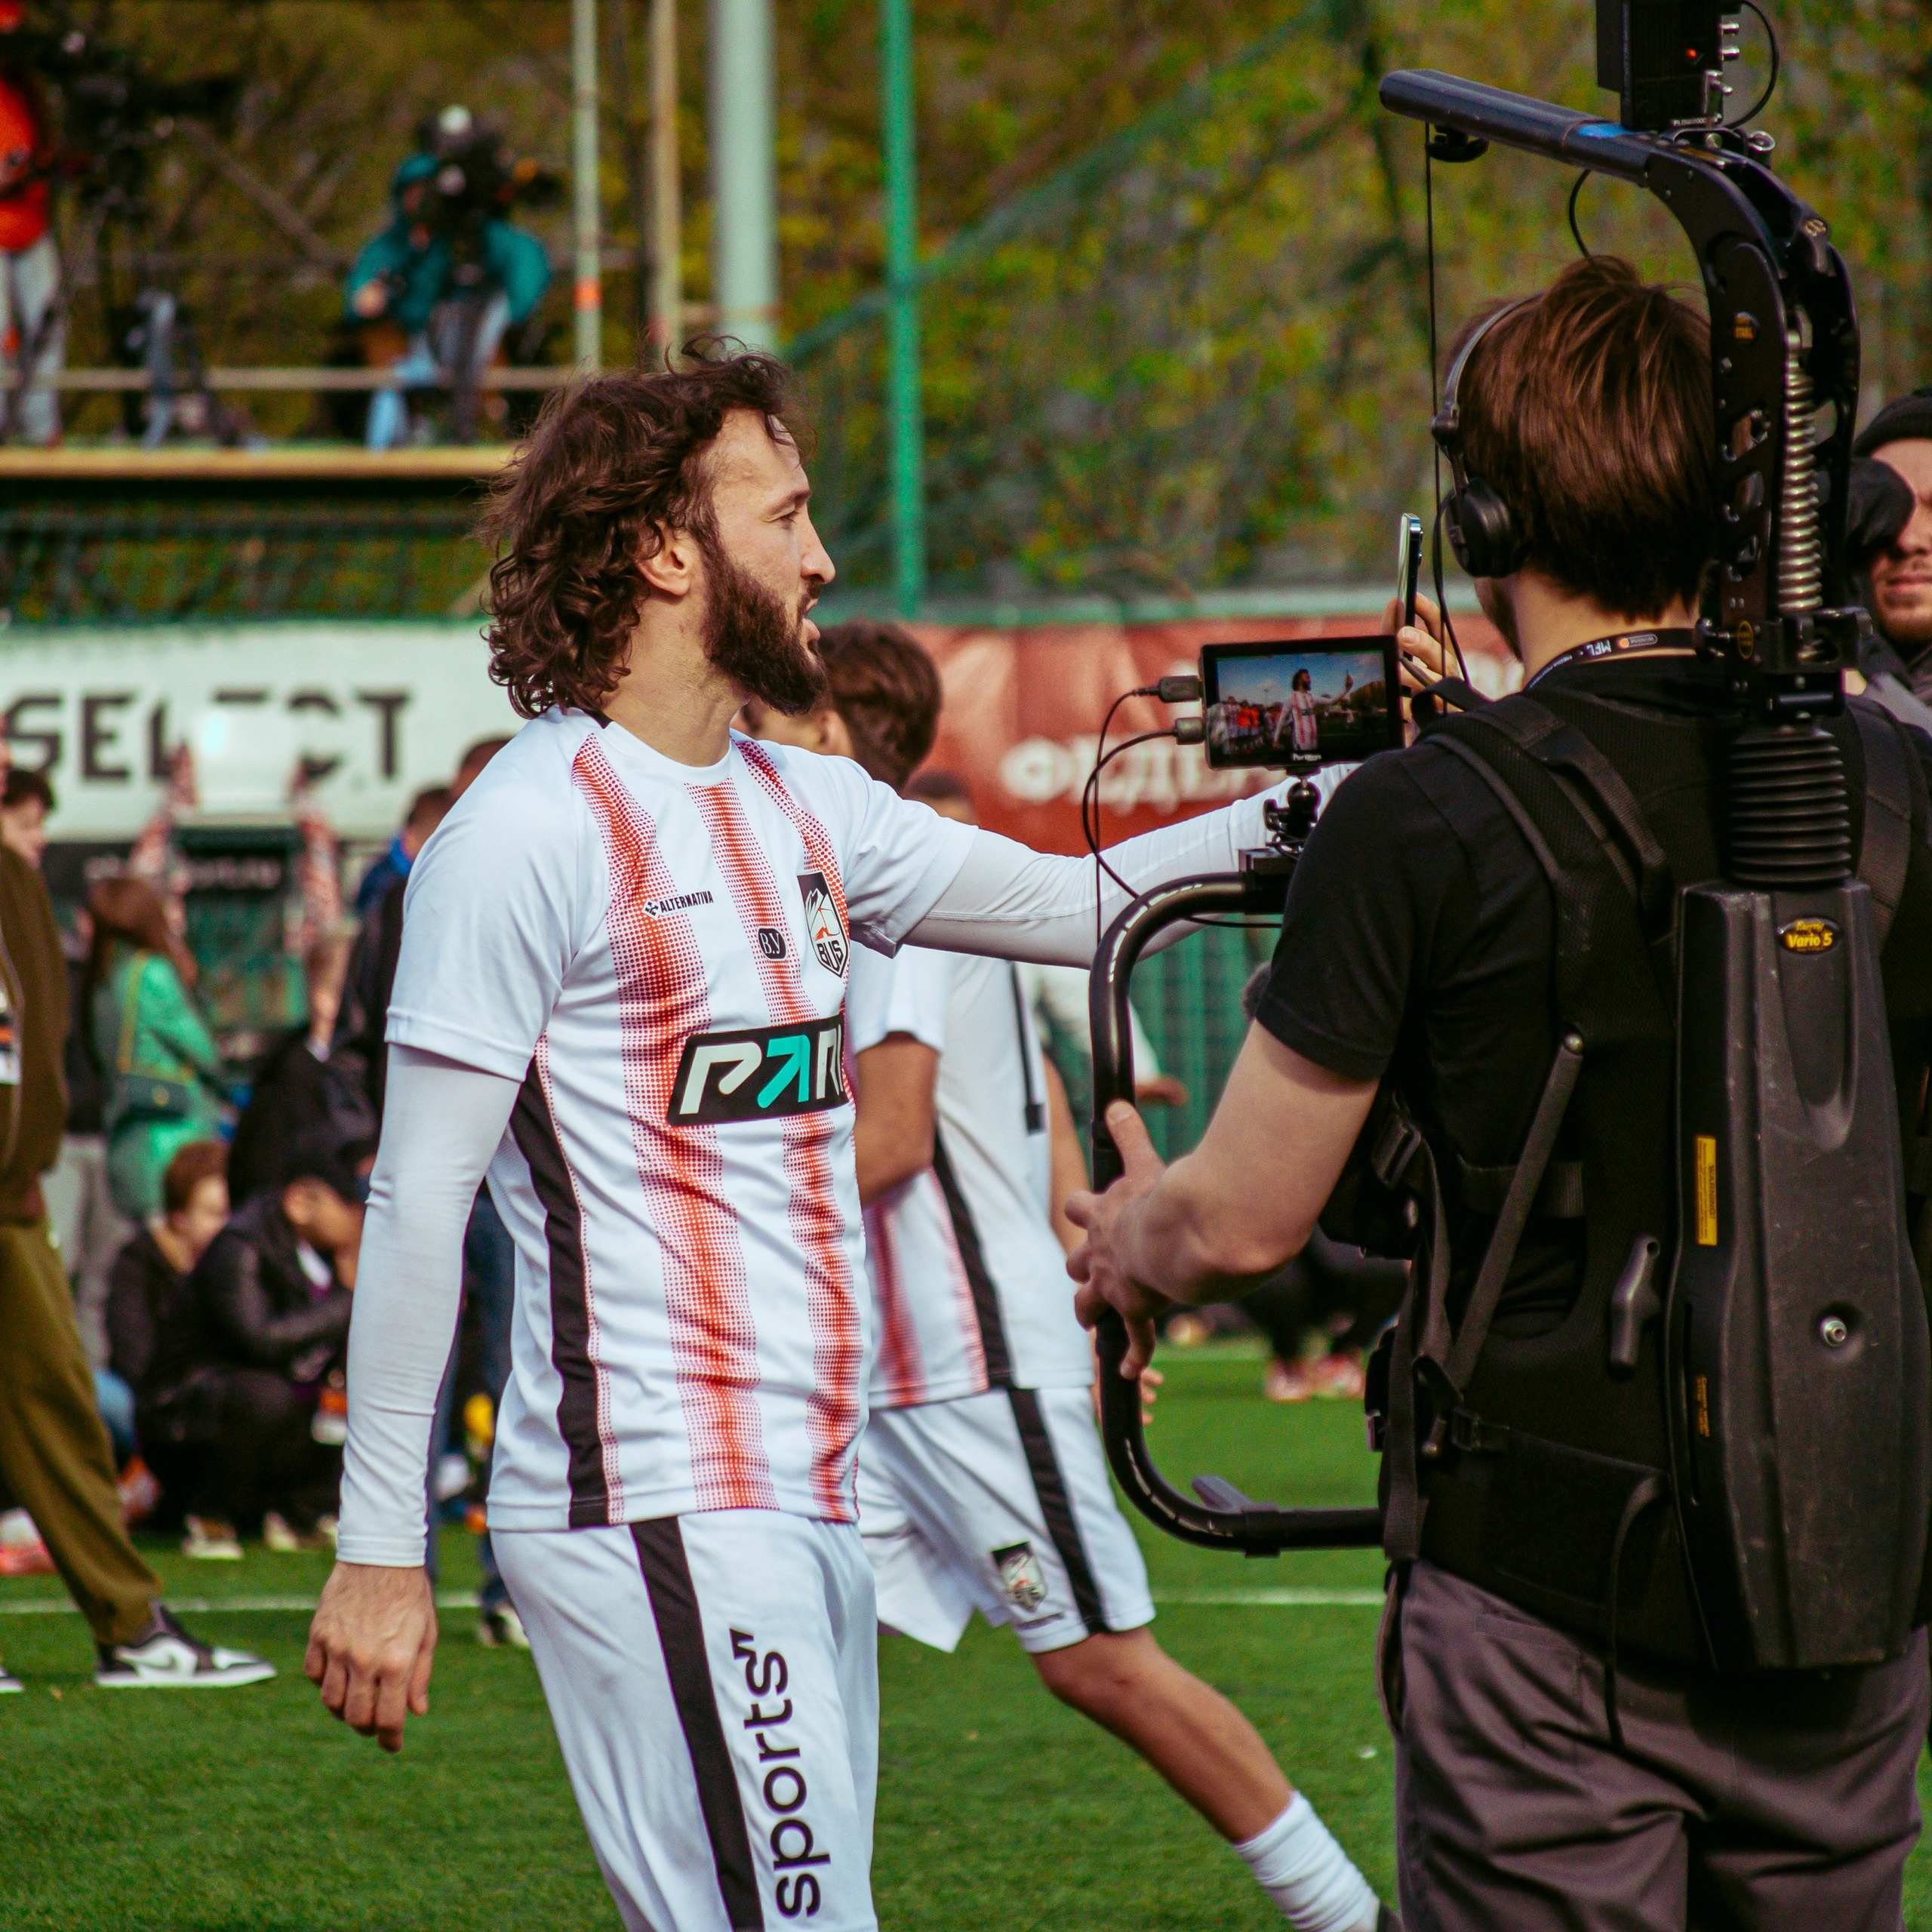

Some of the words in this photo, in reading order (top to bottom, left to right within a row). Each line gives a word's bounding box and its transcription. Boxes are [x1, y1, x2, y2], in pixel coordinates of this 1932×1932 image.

[1586, 639, 1611, 657] MFL
[2, 691, 412, 781] SELCT
[660, 891, 714, 913] ALTERNATIVA
[1788, 932, 1821, 948] Vario
[1823, 932, 1833, 946] 5
[817, 940, 844, 973] BUS
